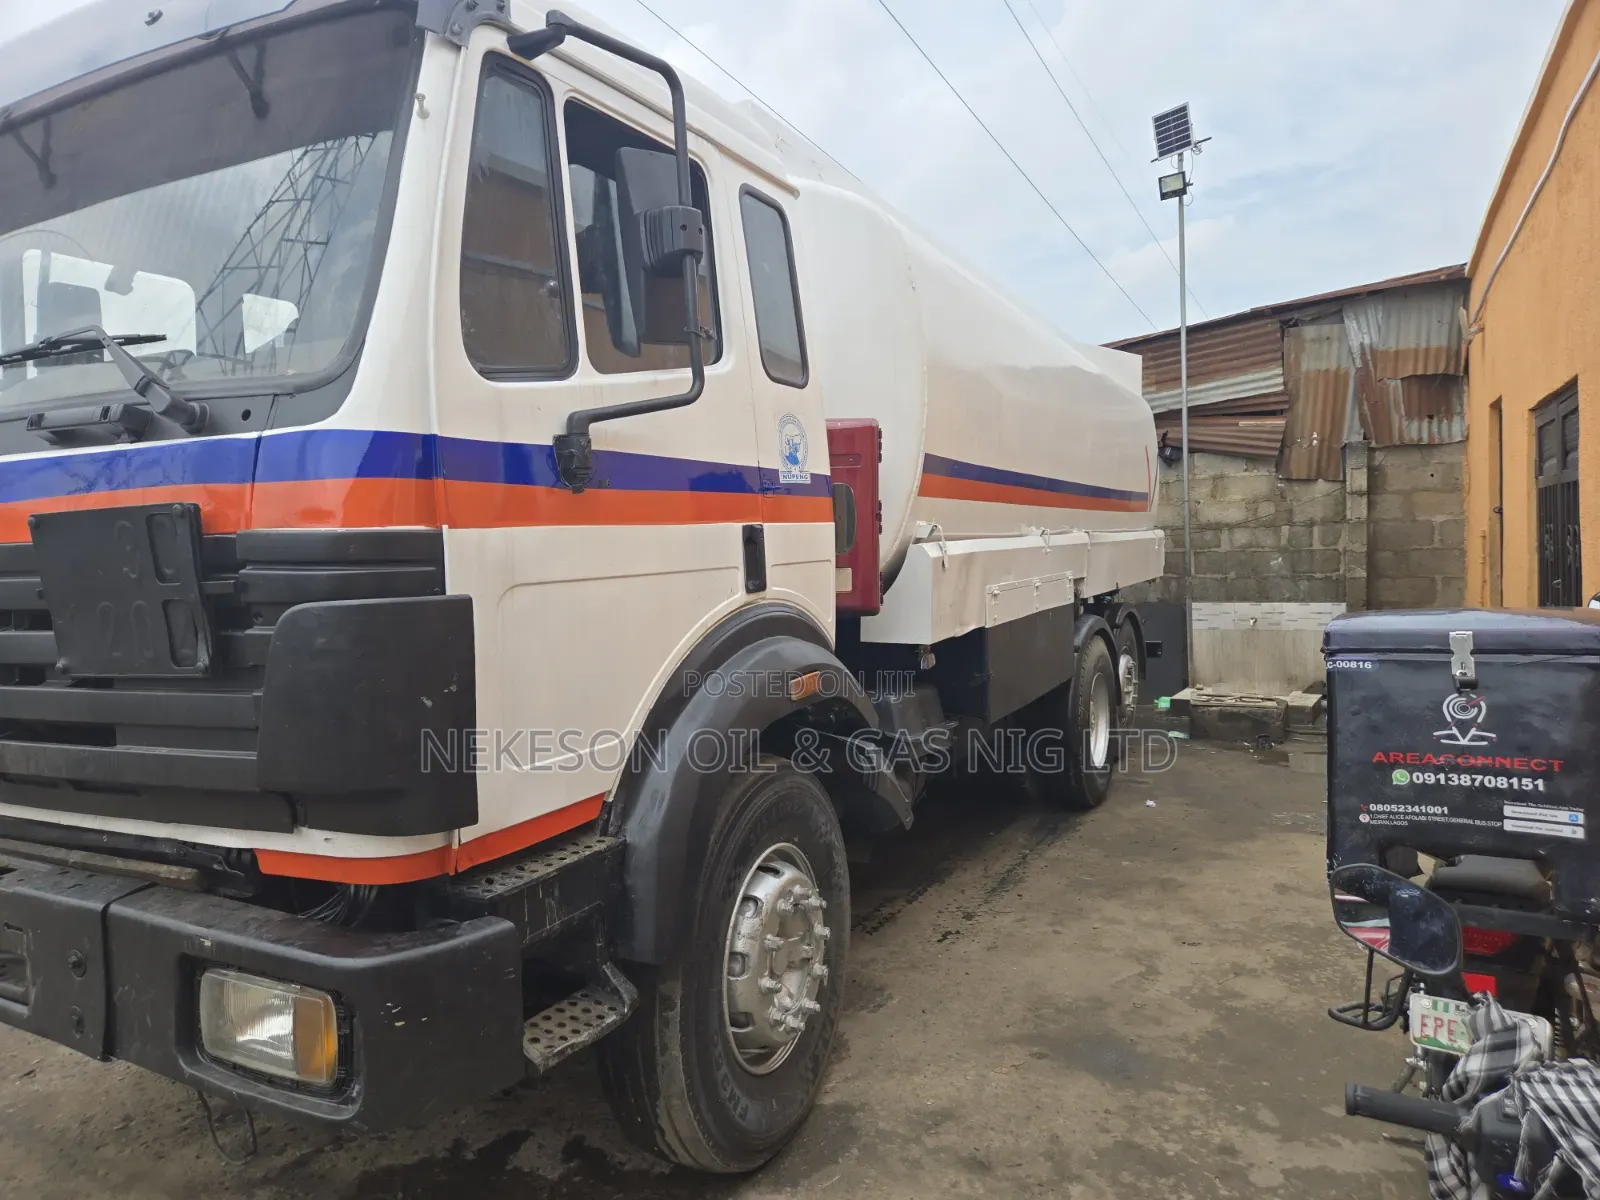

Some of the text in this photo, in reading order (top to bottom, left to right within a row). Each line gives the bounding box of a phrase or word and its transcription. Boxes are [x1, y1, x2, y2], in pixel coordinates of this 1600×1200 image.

[1326, 661, 1372, 669] C-00816
[1372, 751, 1564, 772] AREACONNECT
[1412, 771, 1544, 791] 09138708151
[1369, 803, 1448, 815] 08052341001
